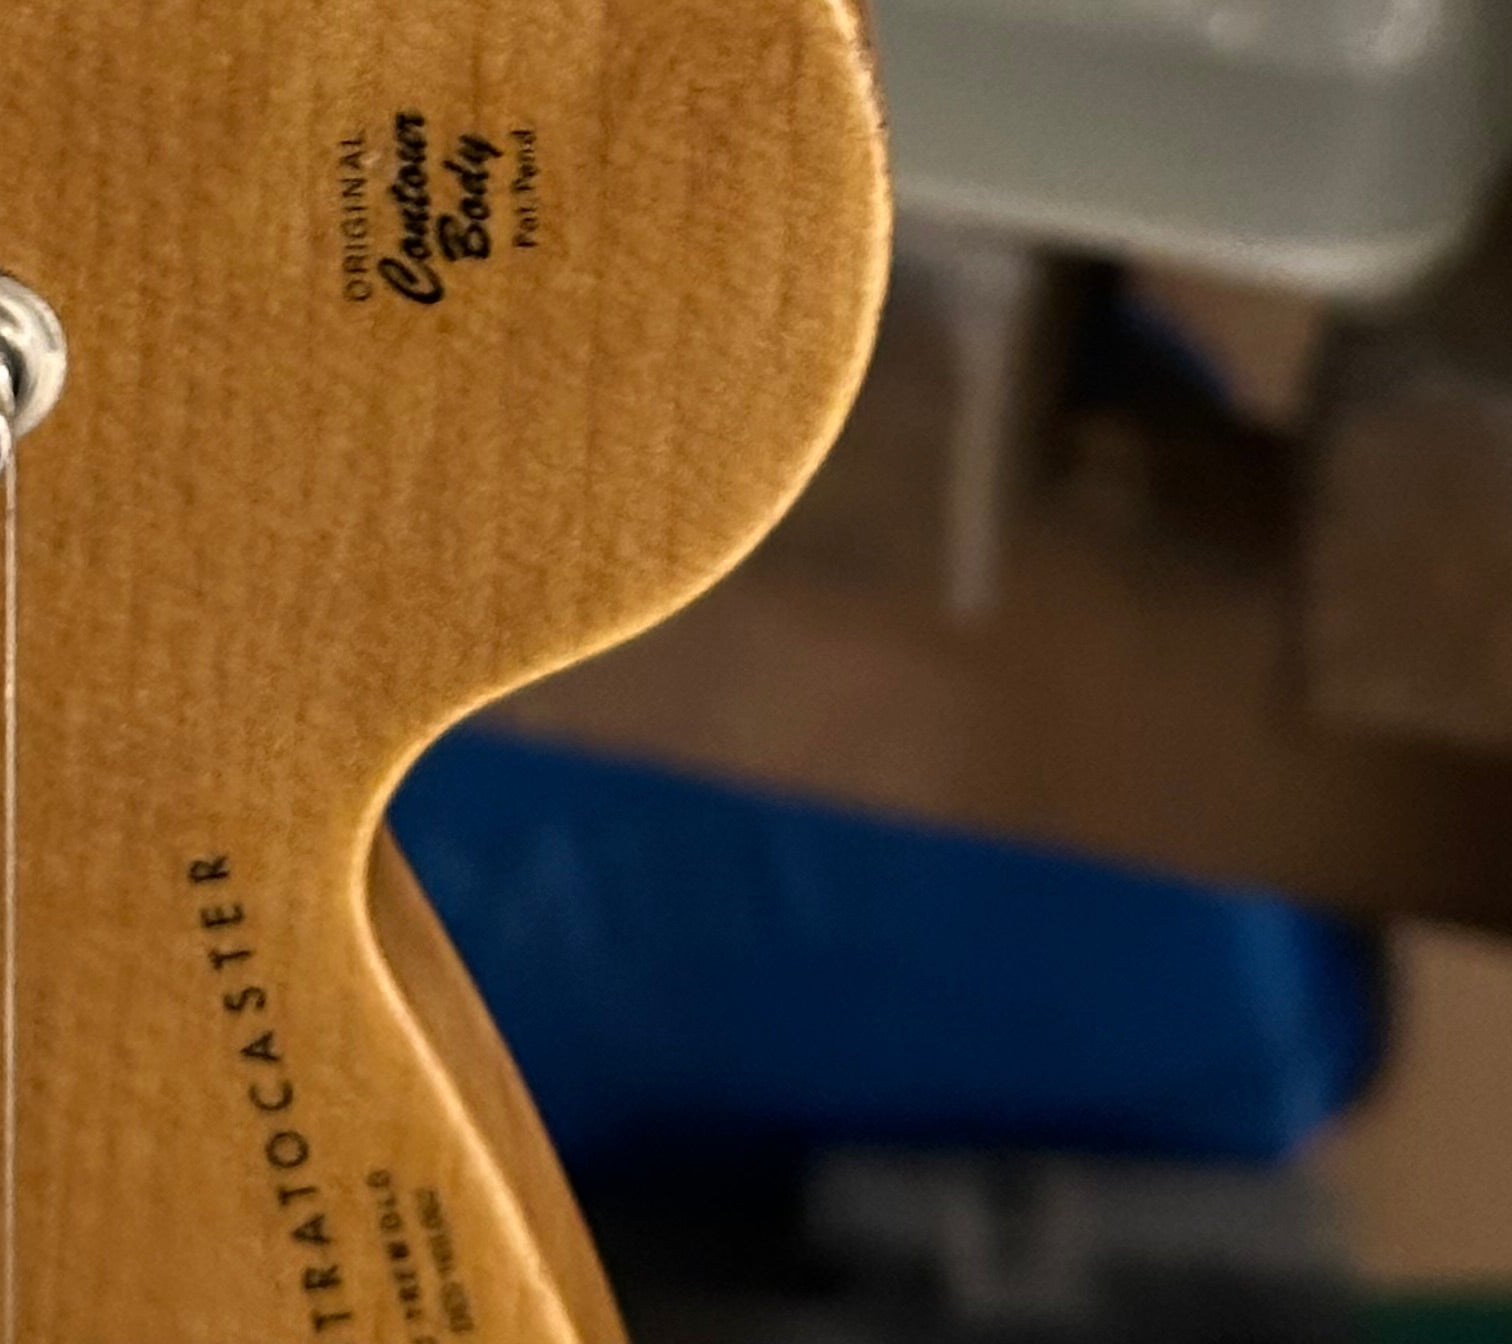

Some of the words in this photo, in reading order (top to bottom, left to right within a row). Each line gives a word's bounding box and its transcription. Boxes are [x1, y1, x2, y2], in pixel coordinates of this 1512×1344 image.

[340, 128, 372, 302] ORIGINAL
[379, 111, 444, 304] Contour
[437, 133, 503, 260] Body
